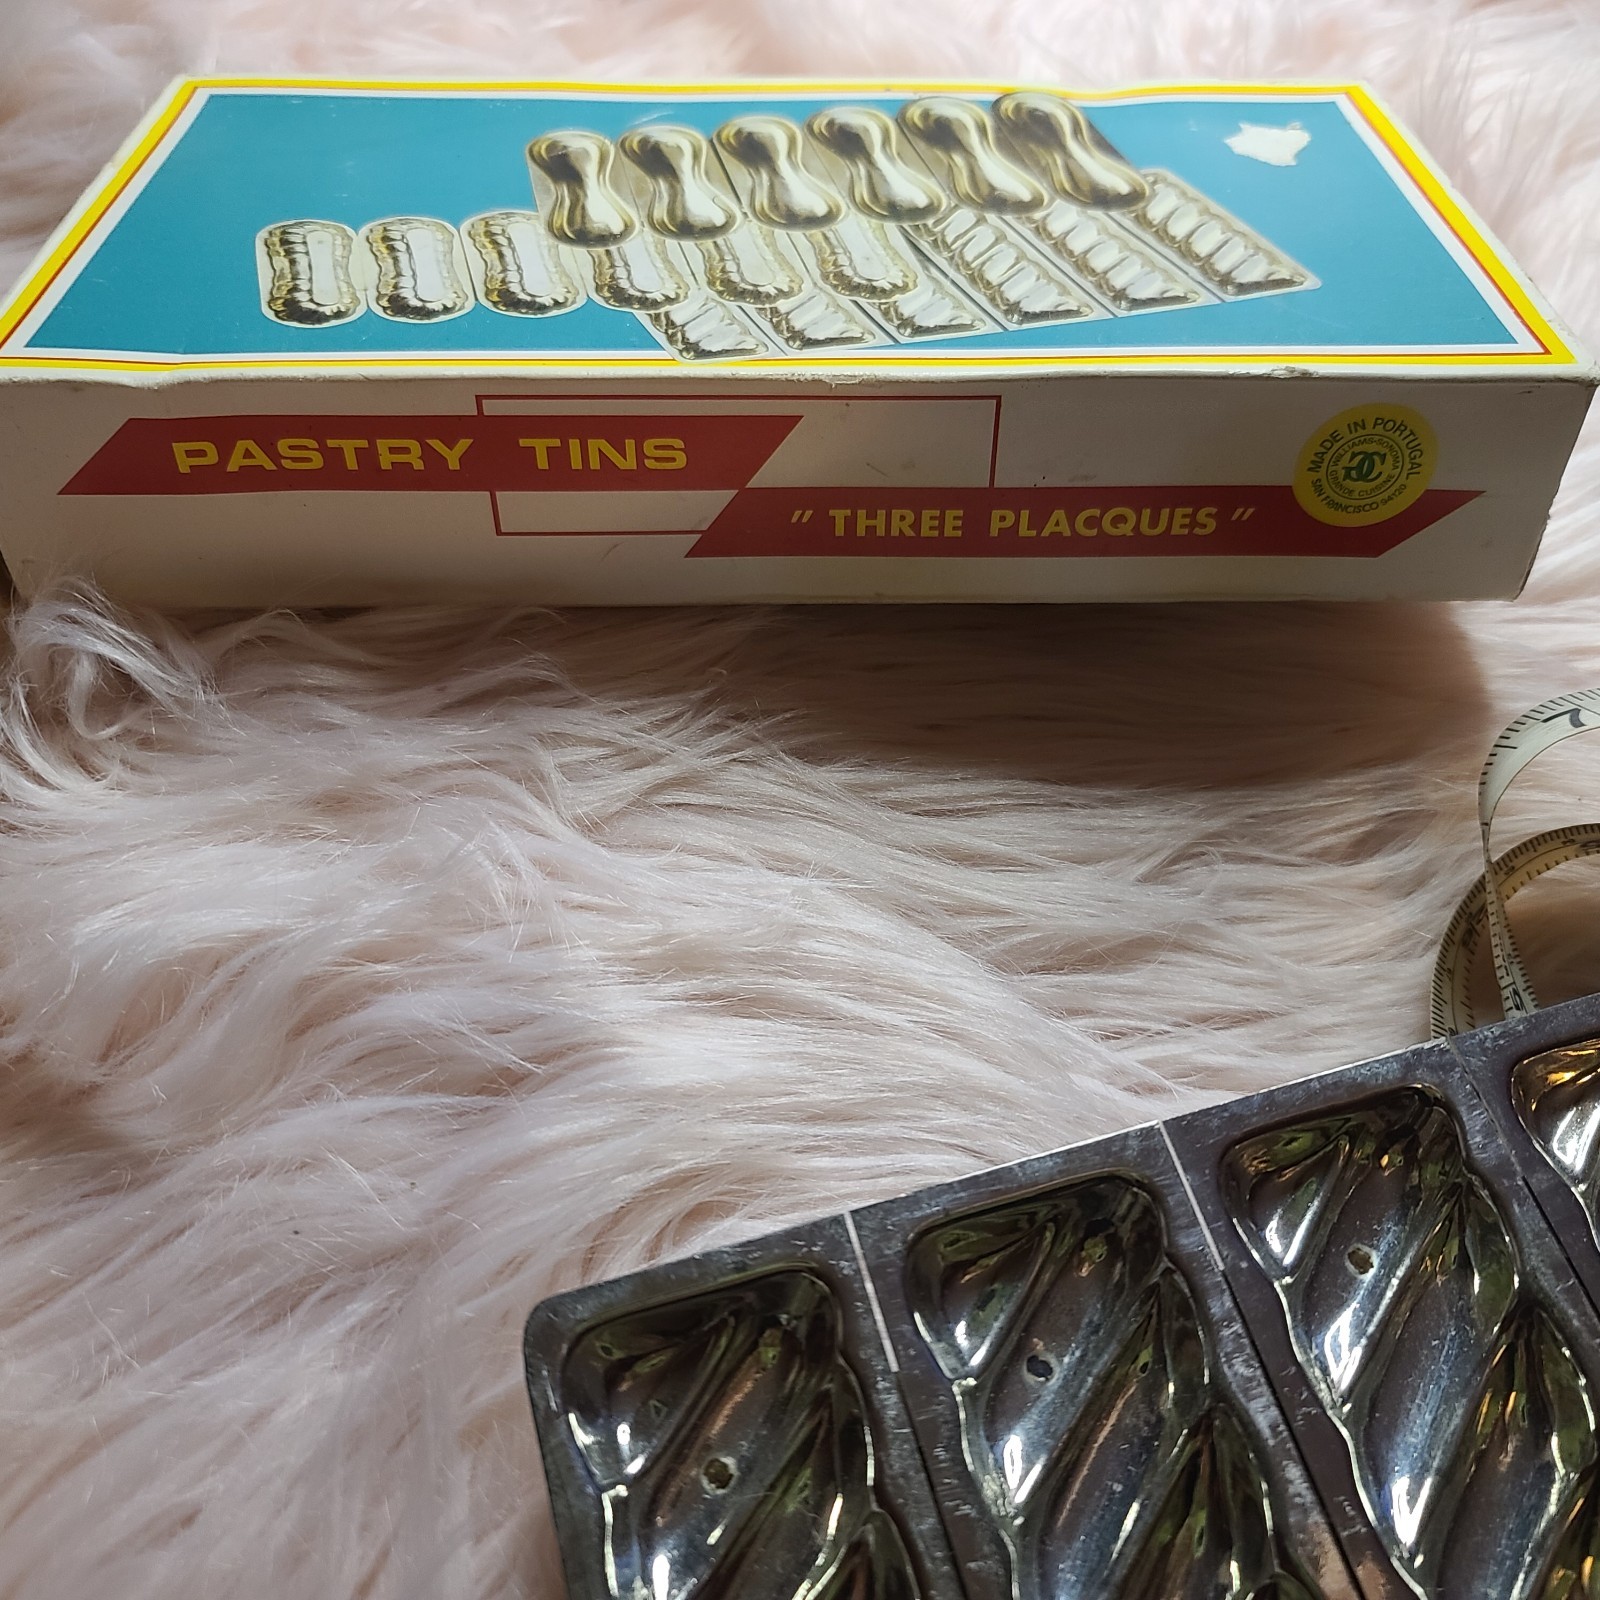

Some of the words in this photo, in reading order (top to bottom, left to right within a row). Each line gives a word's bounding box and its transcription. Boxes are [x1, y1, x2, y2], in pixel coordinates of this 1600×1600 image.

[172, 438, 474, 474] PASTRY
[518, 438, 687, 470] TINS
[1307, 430, 1344, 473] MADE
[1347, 419, 1366, 434] IN
[1372, 417, 1424, 480] PORTUGAL
[1311, 478, 1325, 498] SAN
[1320, 495, 1379, 514] FRANCISCO
[1329, 469, 1355, 497] GRANDE
[1358, 473, 1395, 497] CUISINE
[828, 509, 964, 537] THREE
[989, 507, 1218, 537] PLACQUES
